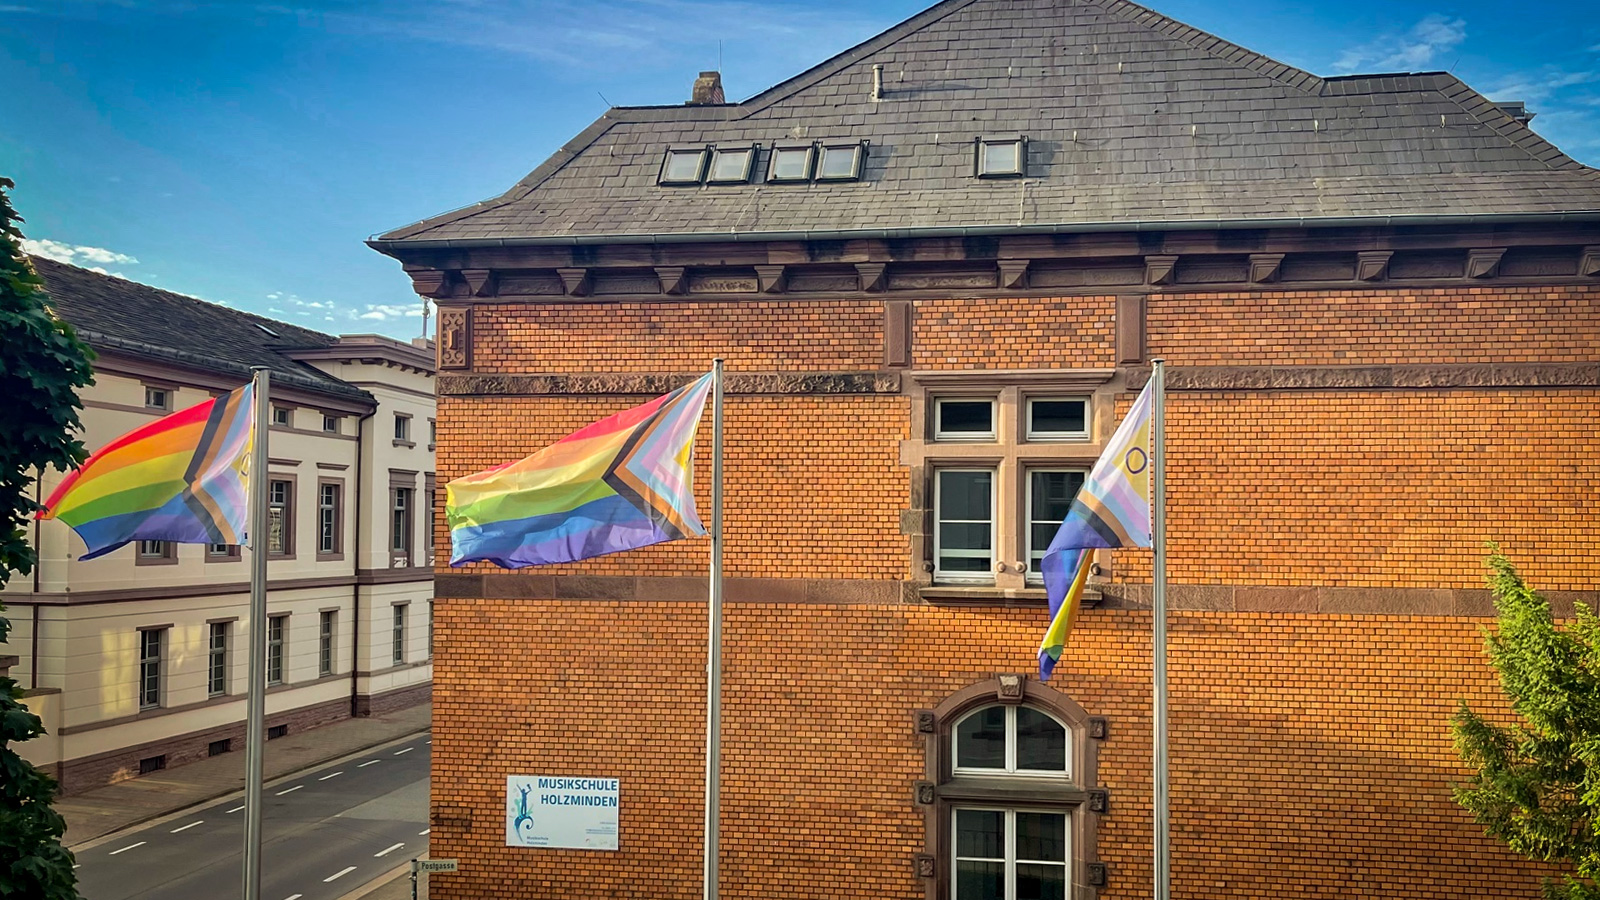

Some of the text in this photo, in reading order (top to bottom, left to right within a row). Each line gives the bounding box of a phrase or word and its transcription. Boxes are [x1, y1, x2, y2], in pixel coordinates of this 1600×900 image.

[538, 778, 618, 791] MUSIKSCHULE
[541, 794, 617, 807] HOLZMINDEN
[421, 862, 455, 871] Postgasse
